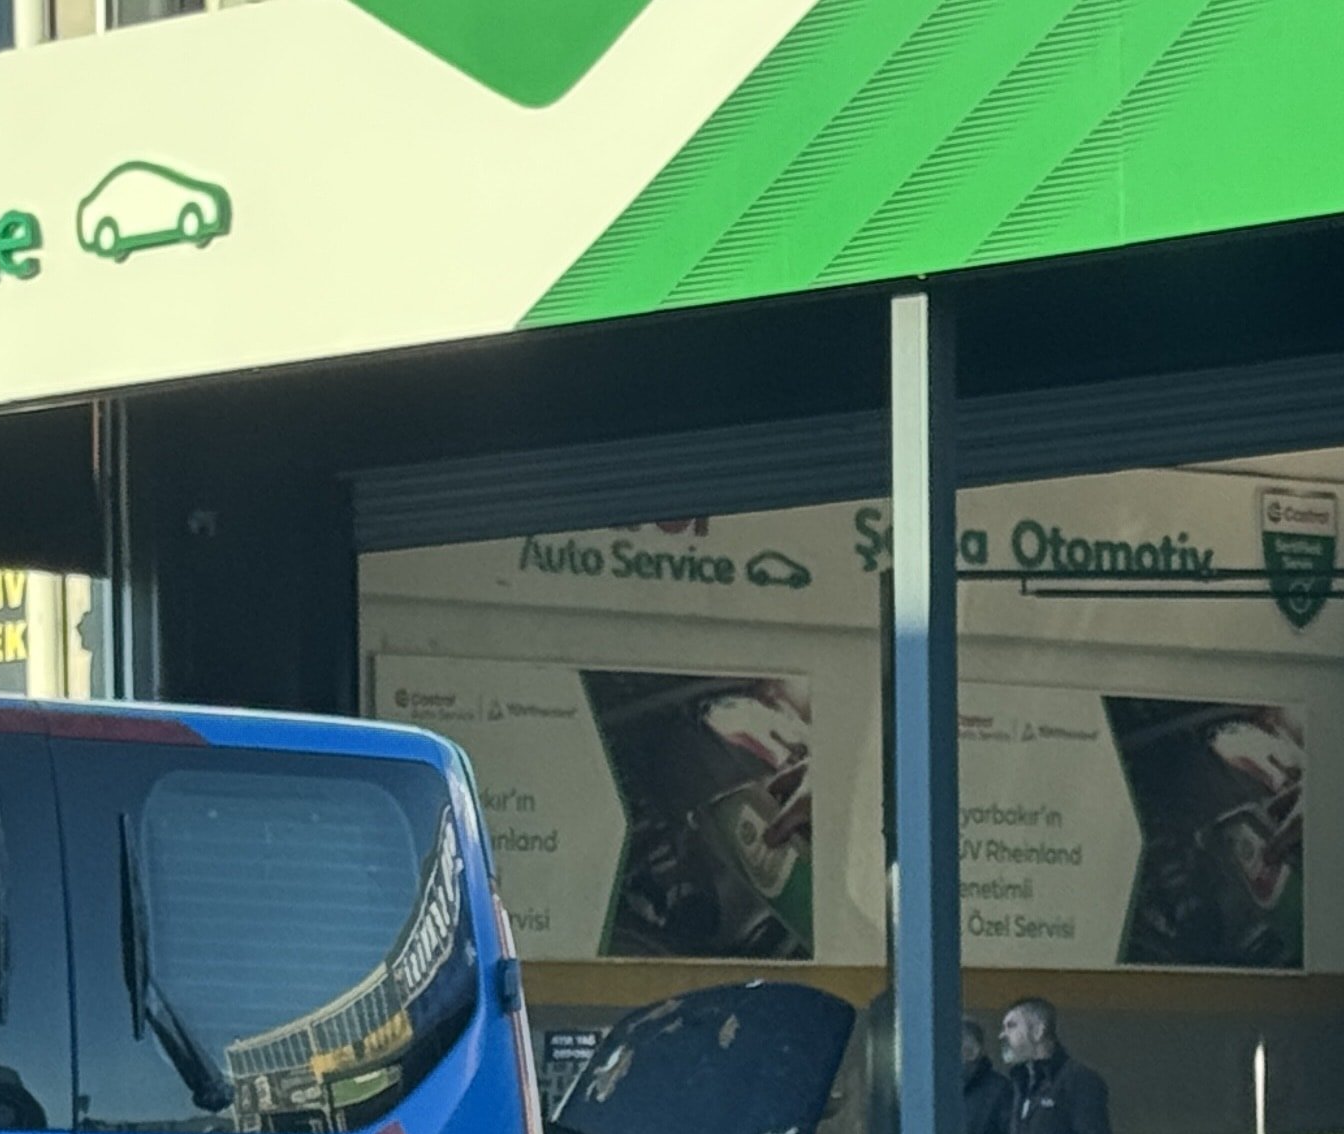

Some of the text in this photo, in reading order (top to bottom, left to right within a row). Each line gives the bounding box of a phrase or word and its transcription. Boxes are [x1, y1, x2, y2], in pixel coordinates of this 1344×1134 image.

[519, 535, 735, 586] Auto Service
[1011, 519, 1214, 582] Otomotiv
[968, 909, 1011, 937] Özel
